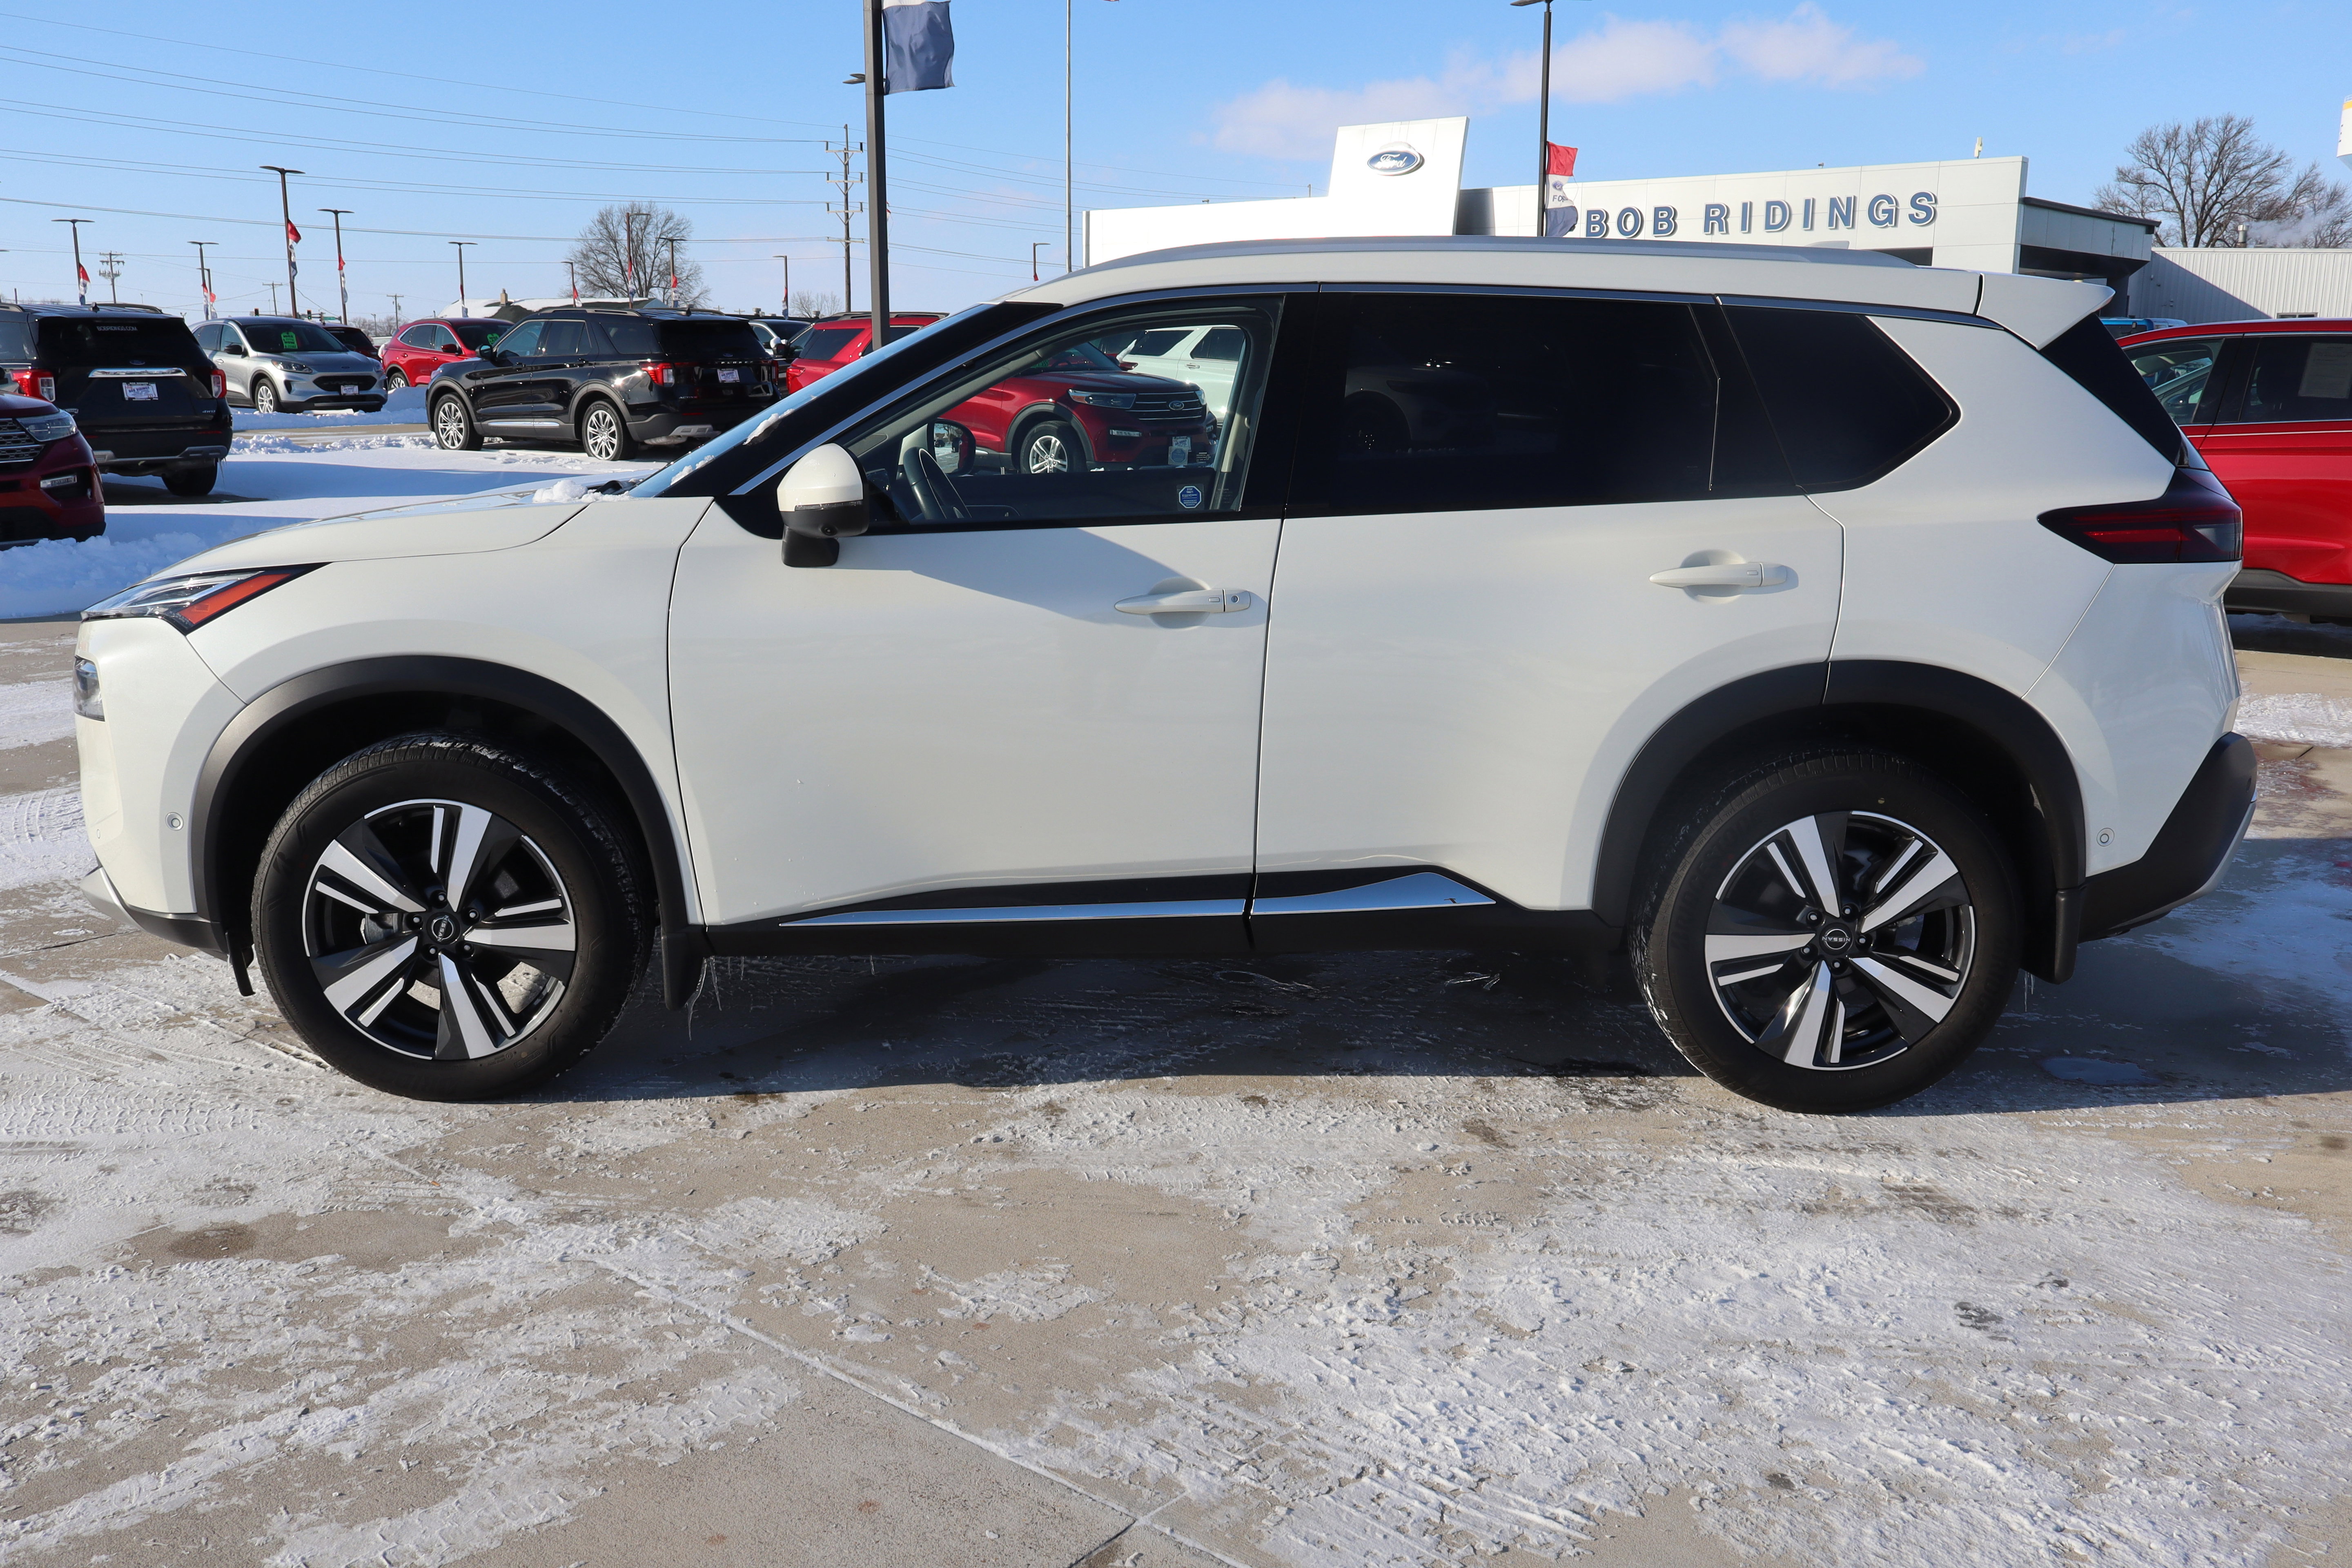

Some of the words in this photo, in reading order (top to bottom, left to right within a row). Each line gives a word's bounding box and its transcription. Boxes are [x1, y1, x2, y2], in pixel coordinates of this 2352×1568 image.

[1585, 205, 1675, 238] BOB
[1704, 191, 1937, 235] RIDINGS
[437, 915, 449, 942] NISSAN
